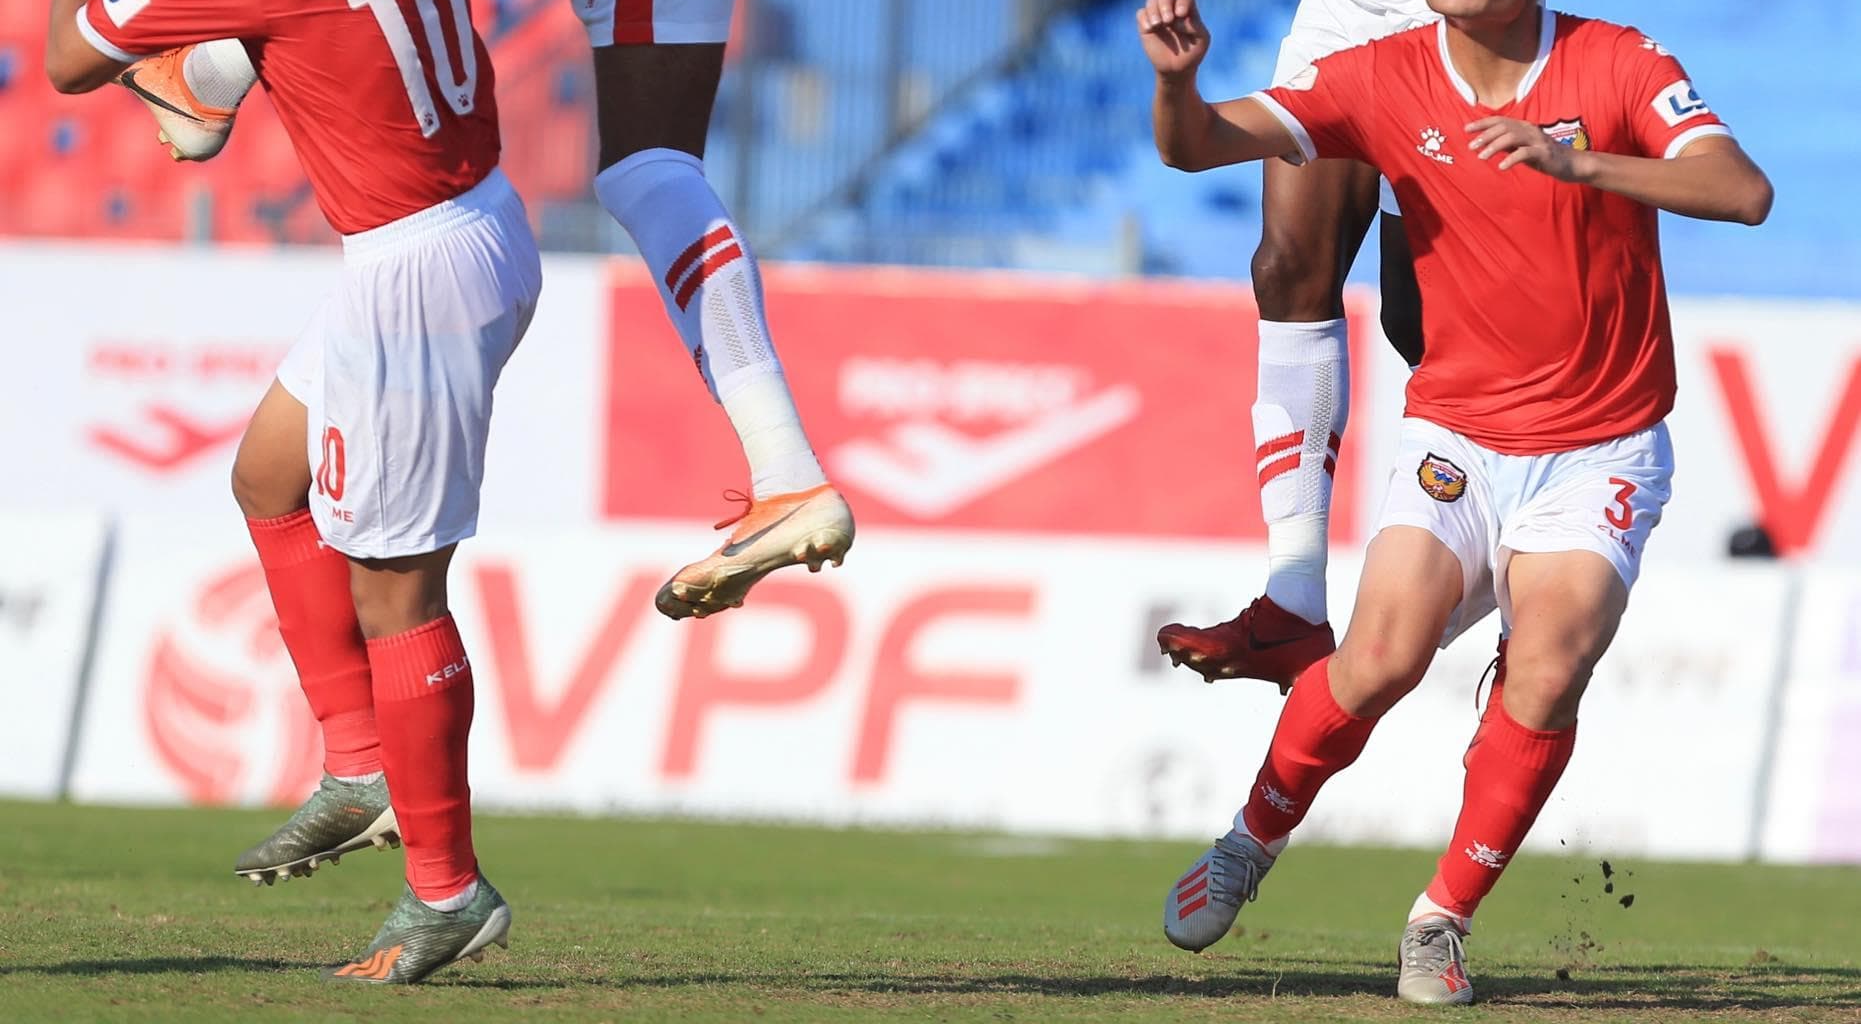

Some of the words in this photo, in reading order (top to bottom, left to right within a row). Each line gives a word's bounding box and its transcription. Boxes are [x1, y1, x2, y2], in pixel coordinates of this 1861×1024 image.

[1604, 477, 1638, 531] 3
[426, 656, 467, 686] KEL
[472, 564, 1037, 791] VPF
